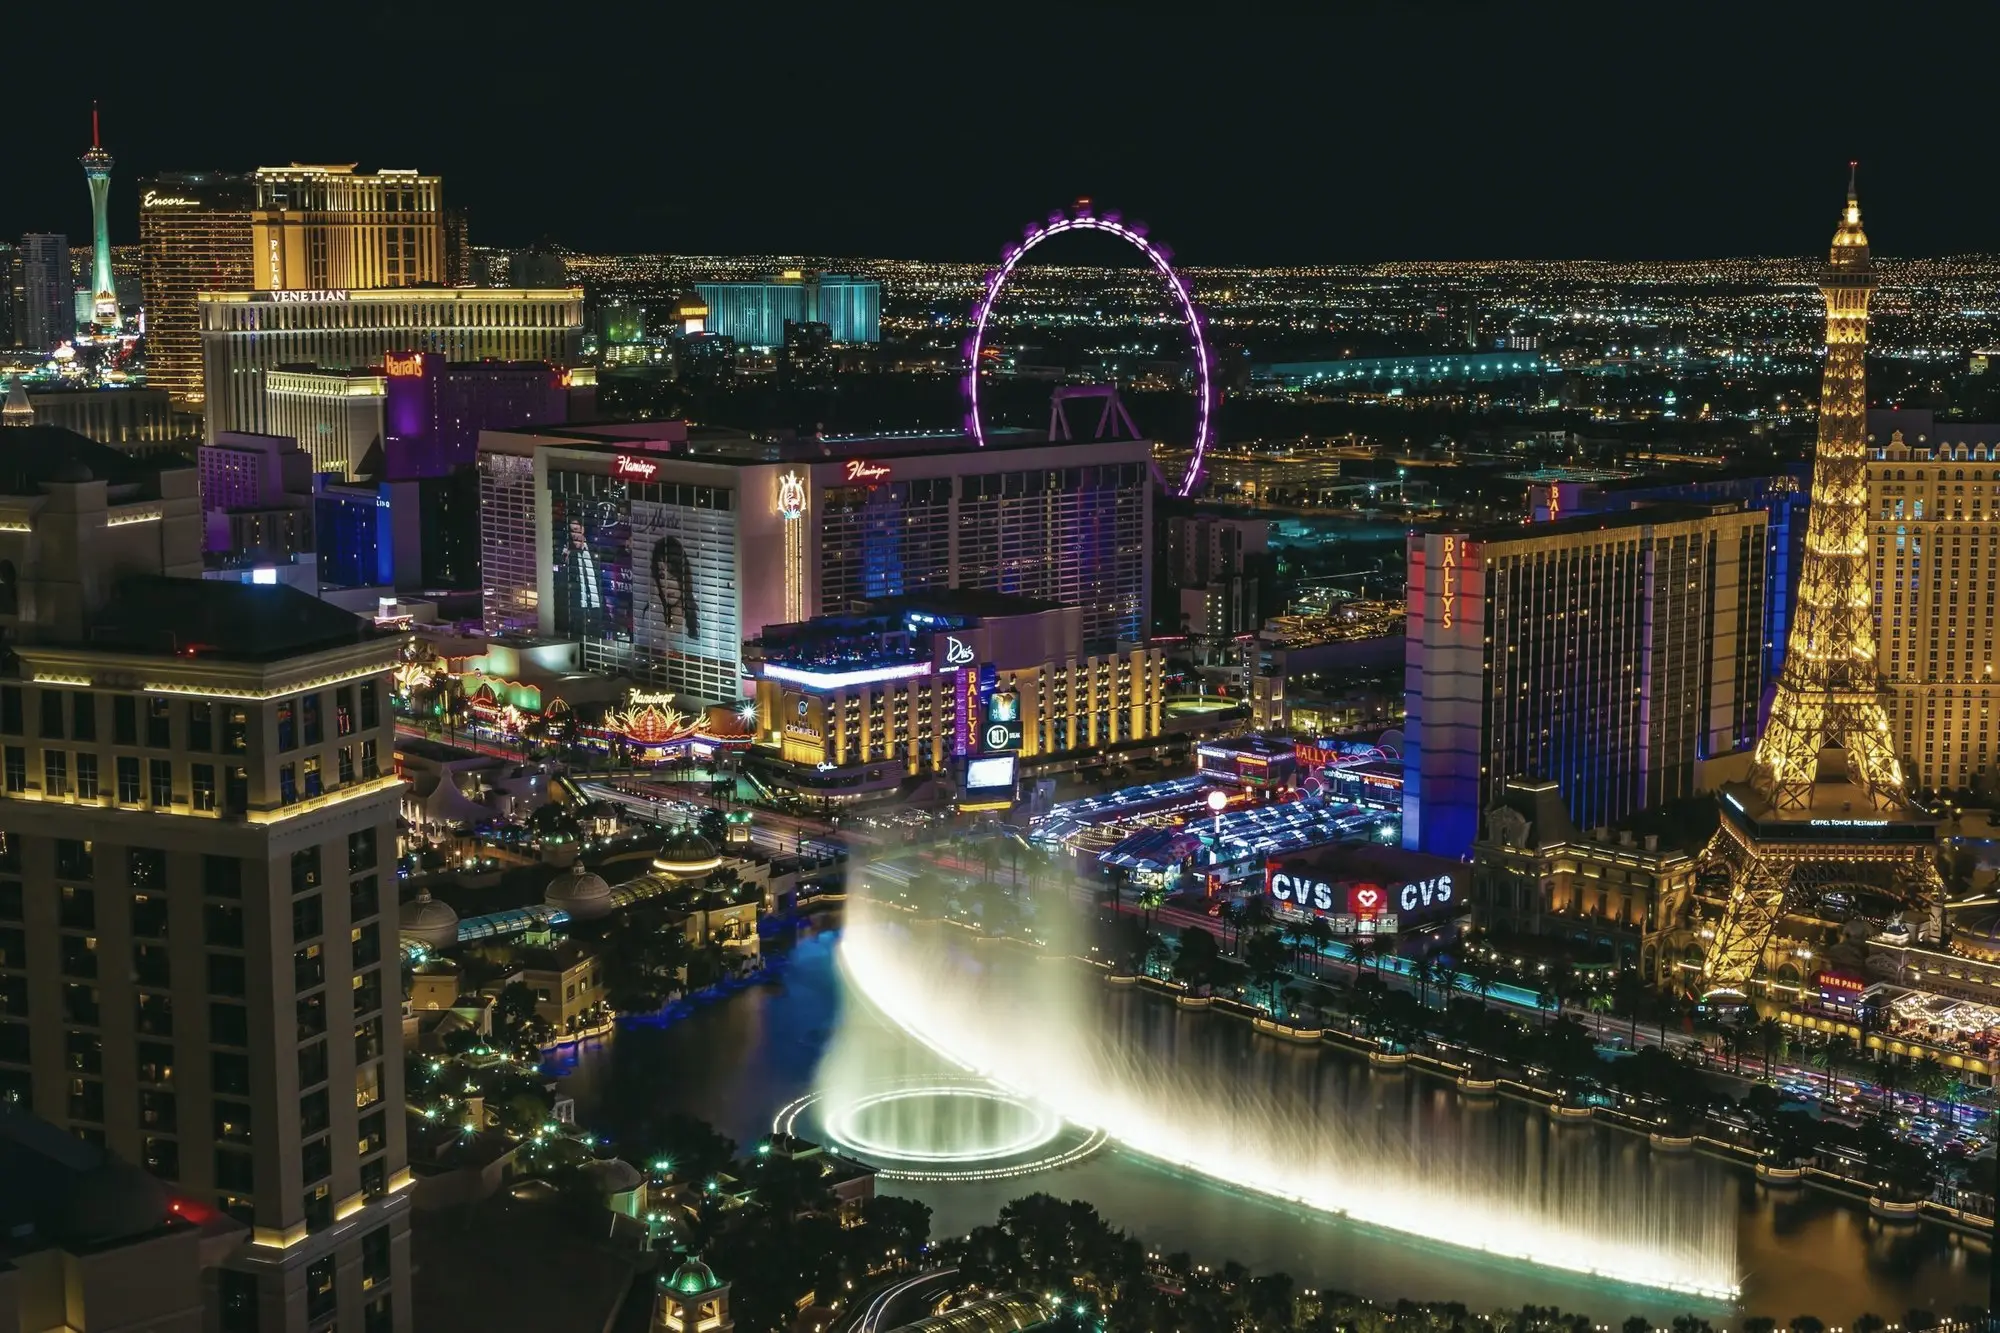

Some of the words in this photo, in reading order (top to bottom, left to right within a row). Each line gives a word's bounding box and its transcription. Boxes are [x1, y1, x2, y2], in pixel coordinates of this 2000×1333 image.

[144, 190, 200, 207] Encore
[271, 290, 346, 302] VENETIAN
[617, 455, 656, 479] Flamingo
[846, 460, 890, 480] Flamingo
[1442, 536, 1456, 629] BALLYS
[629, 687, 676, 709] Flamingo
[967, 671, 978, 745] BALLYS
[991, 730, 1005, 744] BLT
[1271, 873, 1332, 910] CVS
[1401, 875, 1451, 911] CVS
[1820, 975, 1840, 987] BEER
[1841, 980, 1863, 992] PARK
